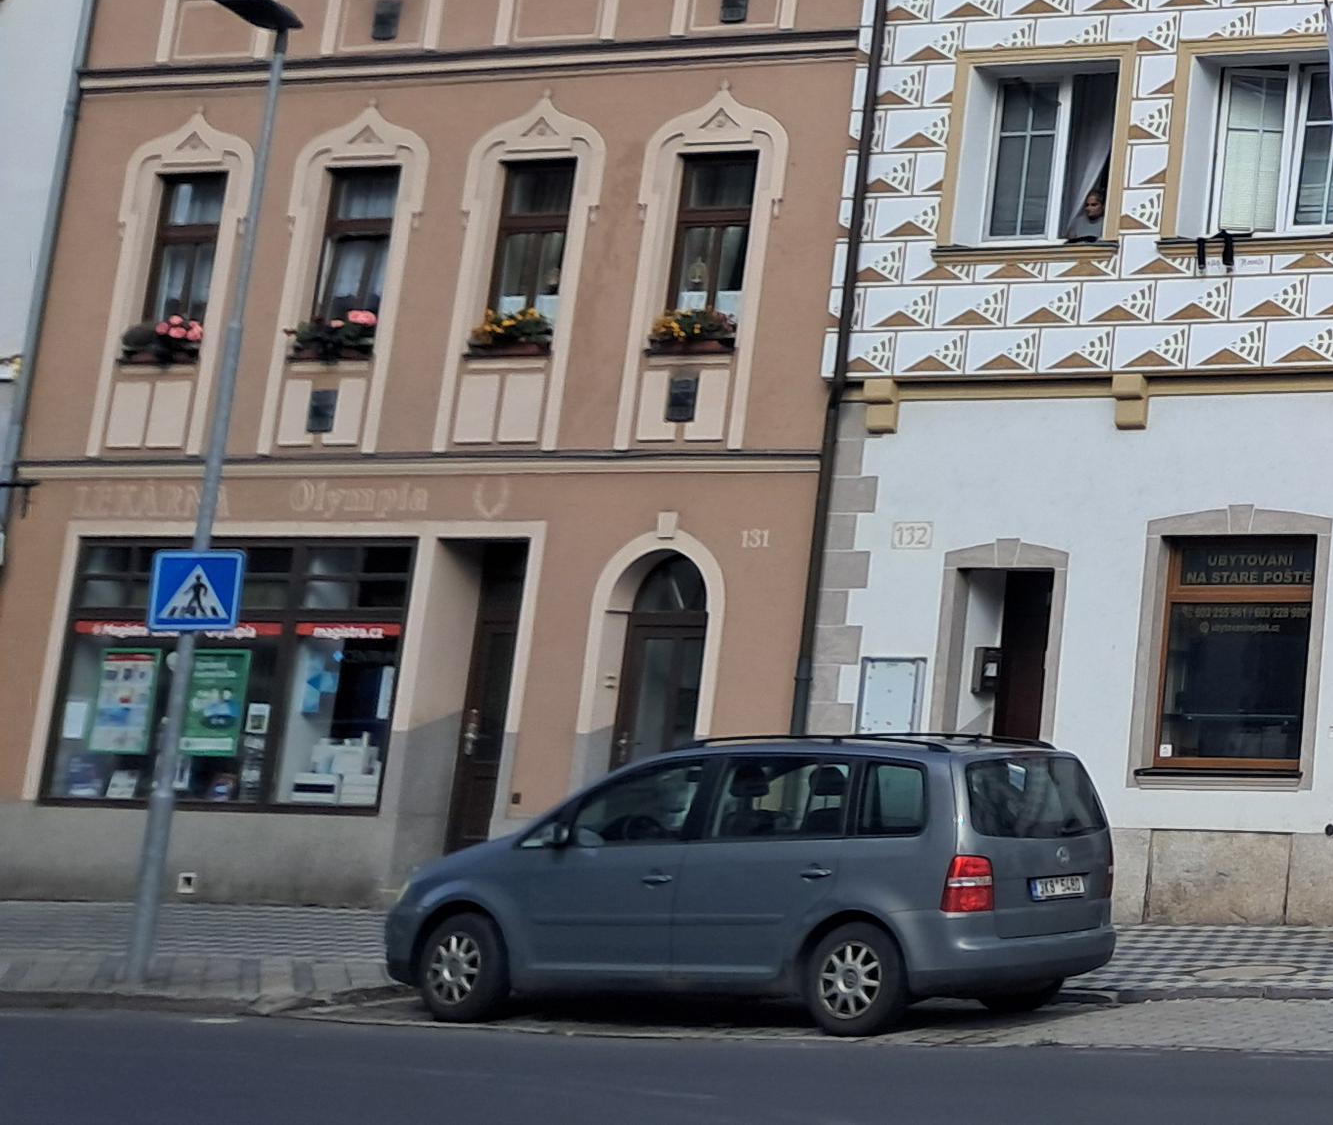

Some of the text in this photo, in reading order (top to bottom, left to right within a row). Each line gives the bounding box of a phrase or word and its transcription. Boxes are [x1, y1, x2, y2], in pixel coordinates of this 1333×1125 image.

[739, 529, 770, 548] 131
[896, 526, 928, 546] 132
[1186, 572, 1207, 584] NA
